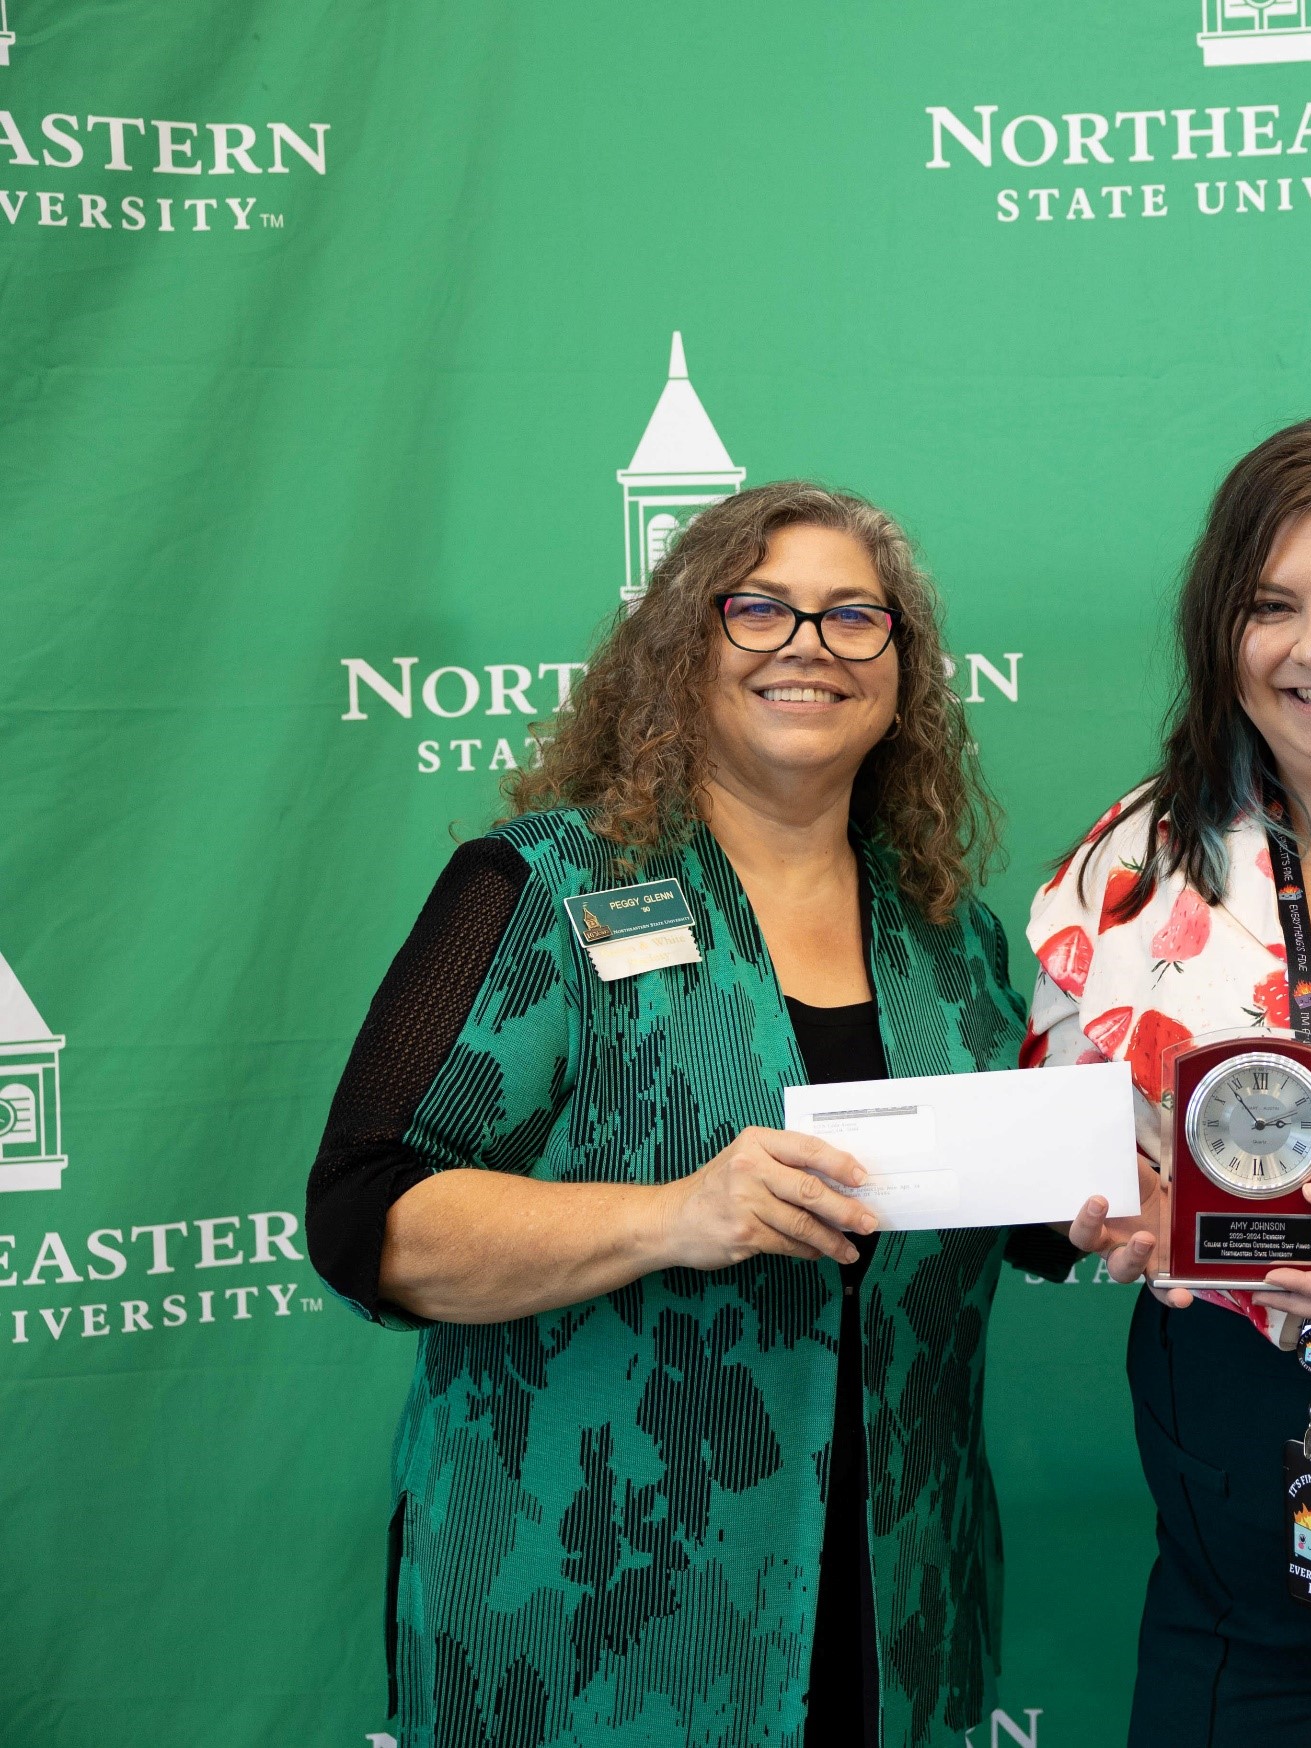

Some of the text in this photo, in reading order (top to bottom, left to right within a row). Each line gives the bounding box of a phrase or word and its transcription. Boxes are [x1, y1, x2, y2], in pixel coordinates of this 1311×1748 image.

[0, 190, 257, 232] VERSITY
[996, 184, 1169, 222] STATE
[609, 890, 675, 911] PEGGY GLENN
[1230, 1221, 1286, 1231] AMY JOHNSON
[1288, 1478, 1302, 1498] IT'S
